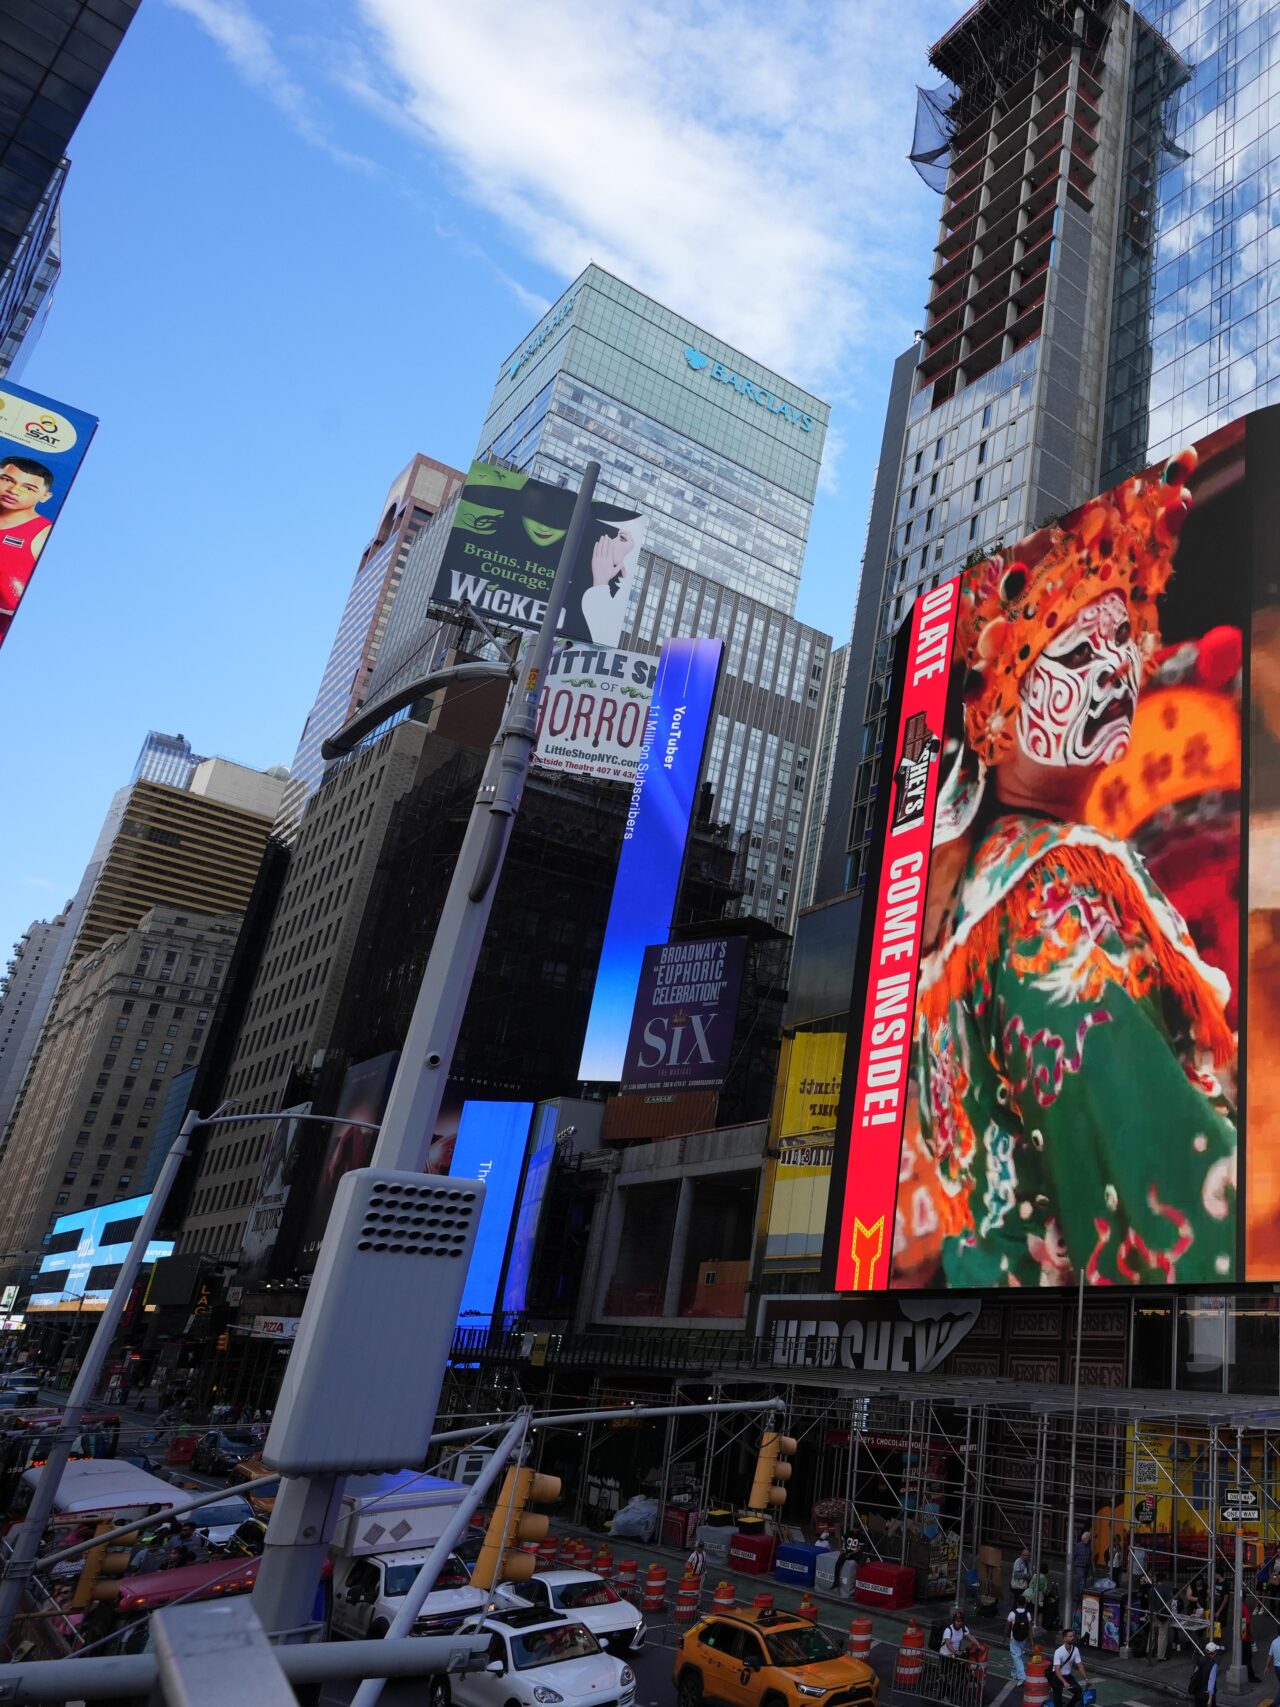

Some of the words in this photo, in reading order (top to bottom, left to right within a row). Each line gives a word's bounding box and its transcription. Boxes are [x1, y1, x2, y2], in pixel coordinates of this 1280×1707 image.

[710, 361, 813, 434] BARCLAYS
[463, 542, 521, 569] Brains.
[480, 562, 550, 591] Courage.
[548, 650, 628, 679] ITTLE
[600, 682, 618, 692] OF
[641, 720, 658, 759] Million
[663, 705, 687, 770] YouTuber
[529, 756, 563, 768] estside
[565, 760, 594, 773] Theatre
[596, 765, 611, 775] 407
[613, 767, 622, 776] W
[622, 768, 639, 780] 43r
[624, 762, 650, 840] Subscribers
[880, 851, 923, 965] COME
[660, 941, 728, 964] BROADWAY'S
[862, 971, 911, 1128] INSIDE!
[263, 1322, 284, 1334] PIZZA
[1015, 1311, 1059, 1332] HERSHEY'S
[1242, 1494, 1254, 1502] WAY
[1227, 1510, 1238, 1518] ONE
[1243, 1510, 1256, 1518] WAY
[847, 1537, 859, 1550] 99
